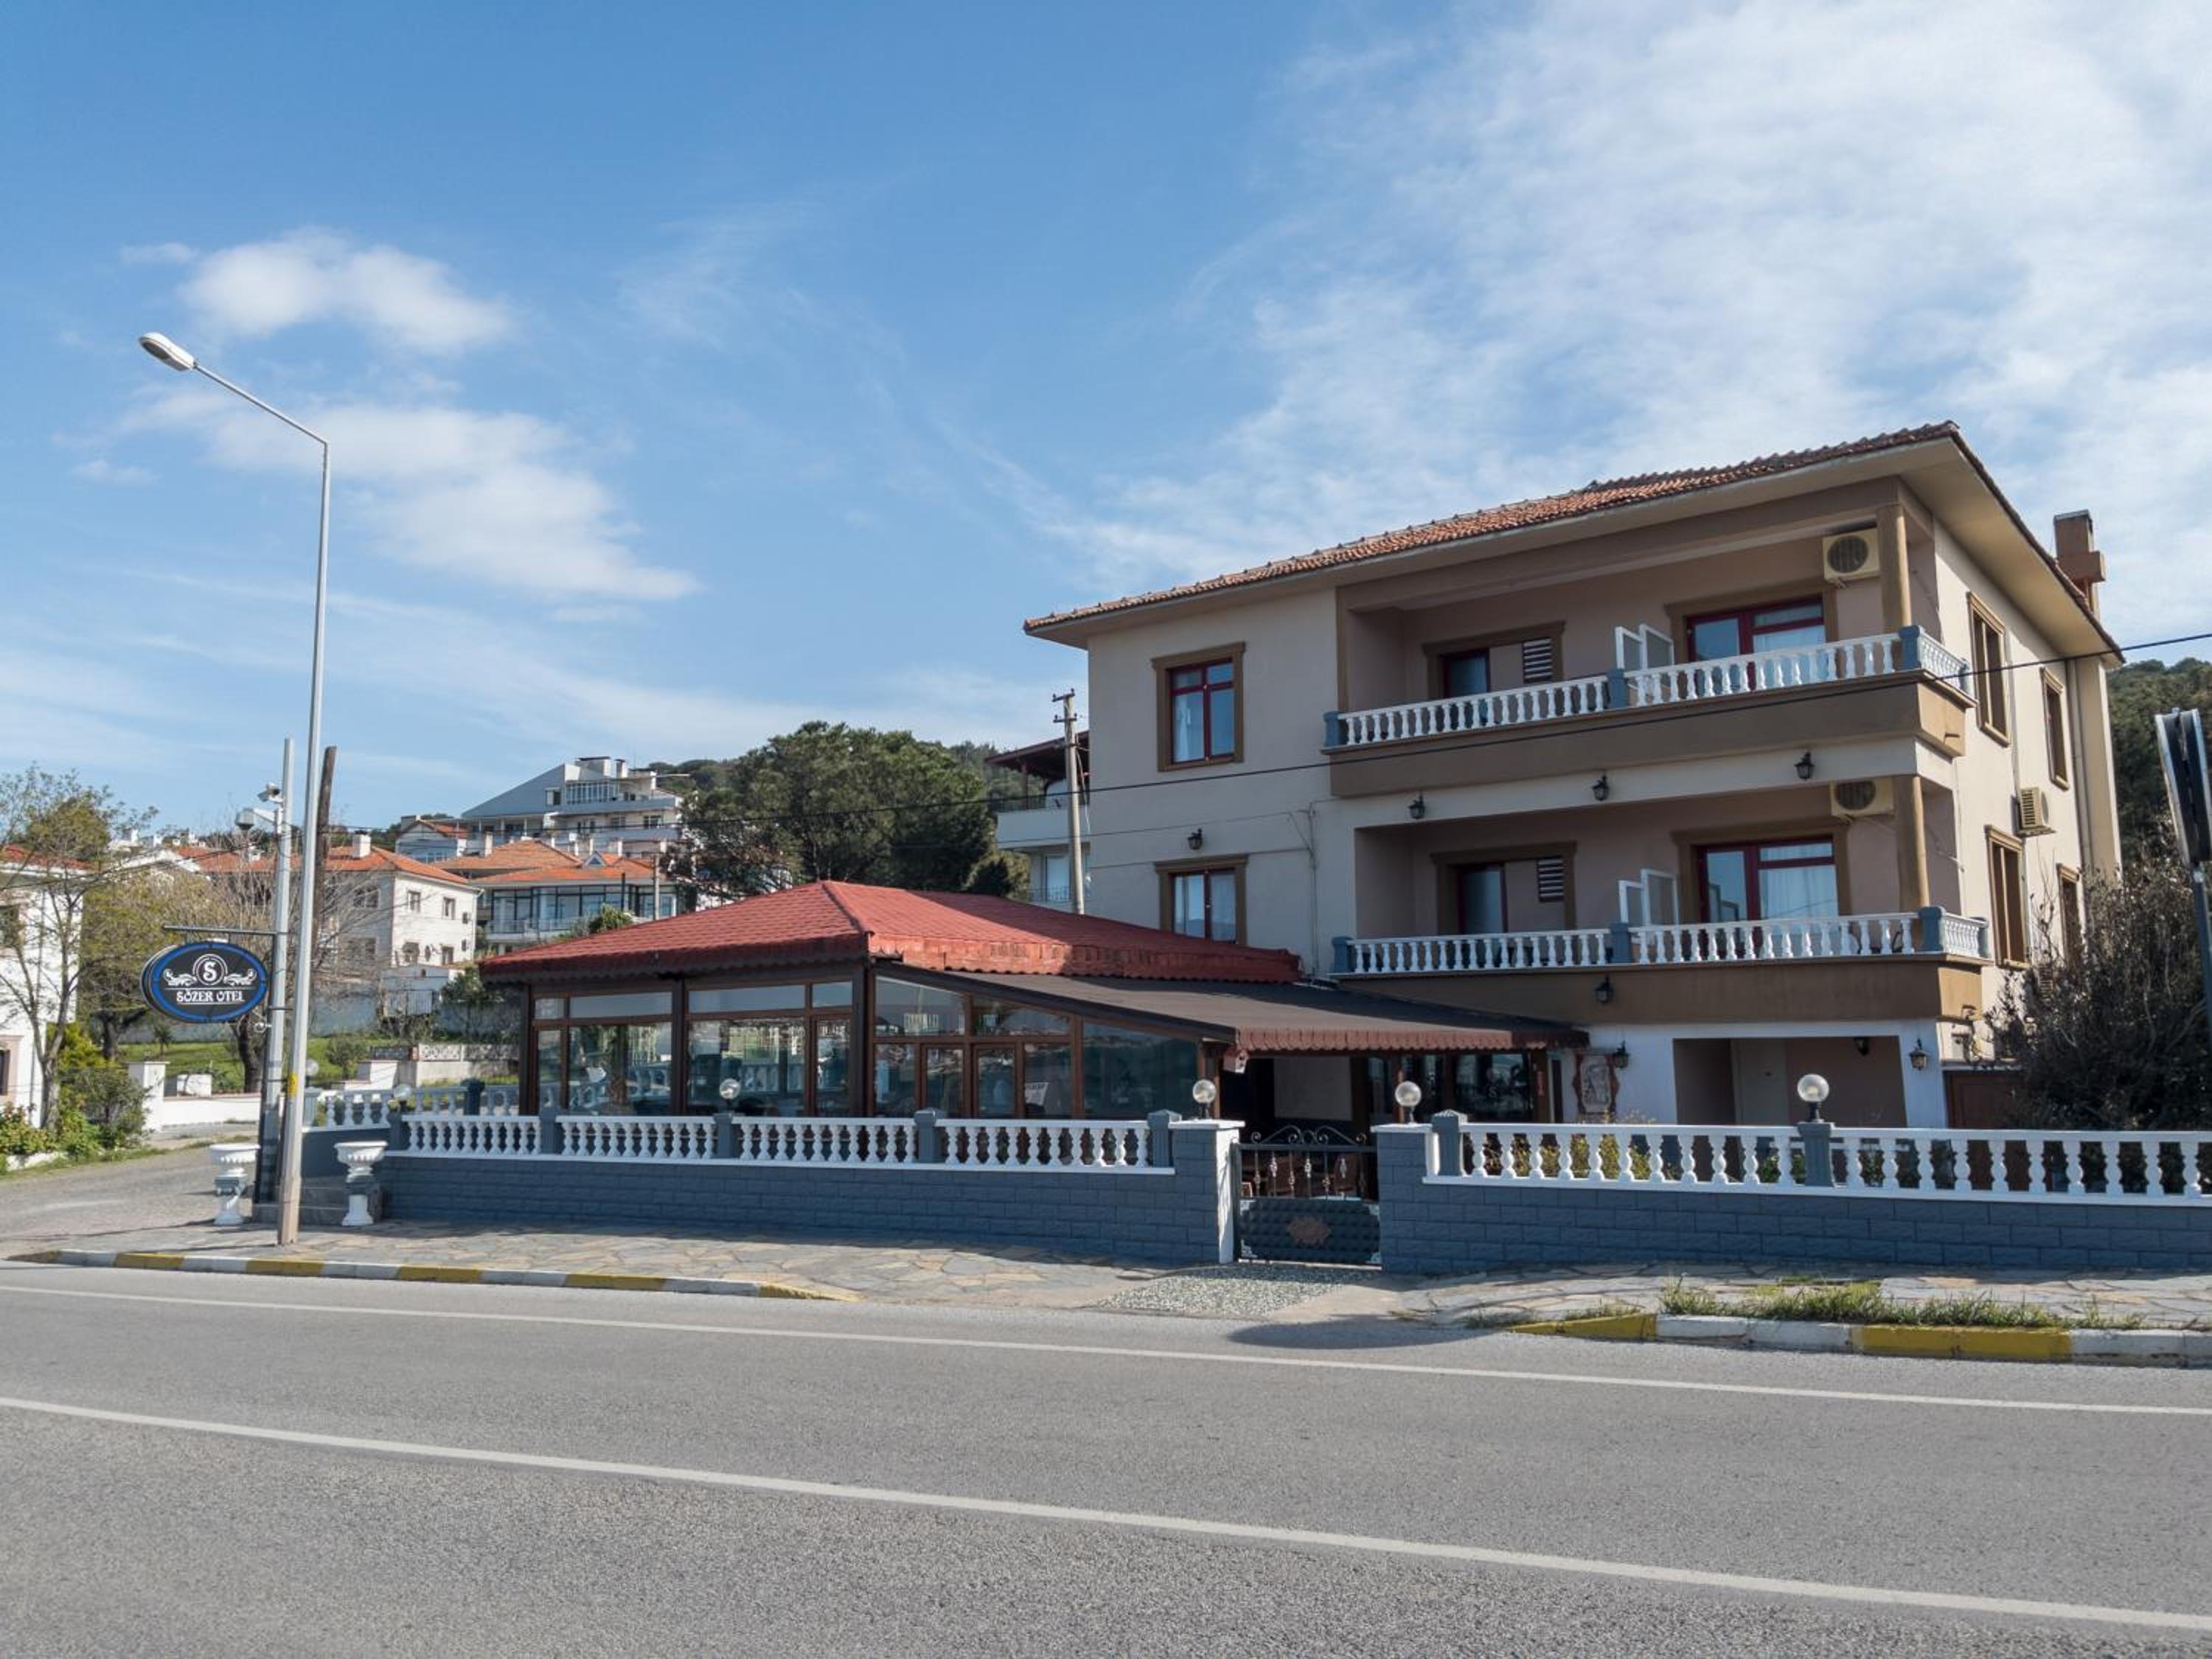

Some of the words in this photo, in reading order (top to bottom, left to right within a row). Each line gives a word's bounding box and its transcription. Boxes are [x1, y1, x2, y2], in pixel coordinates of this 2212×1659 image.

[202, 961, 218, 981] S
[176, 988, 214, 1002] SÖZER
[216, 990, 246, 1003] OTEL
